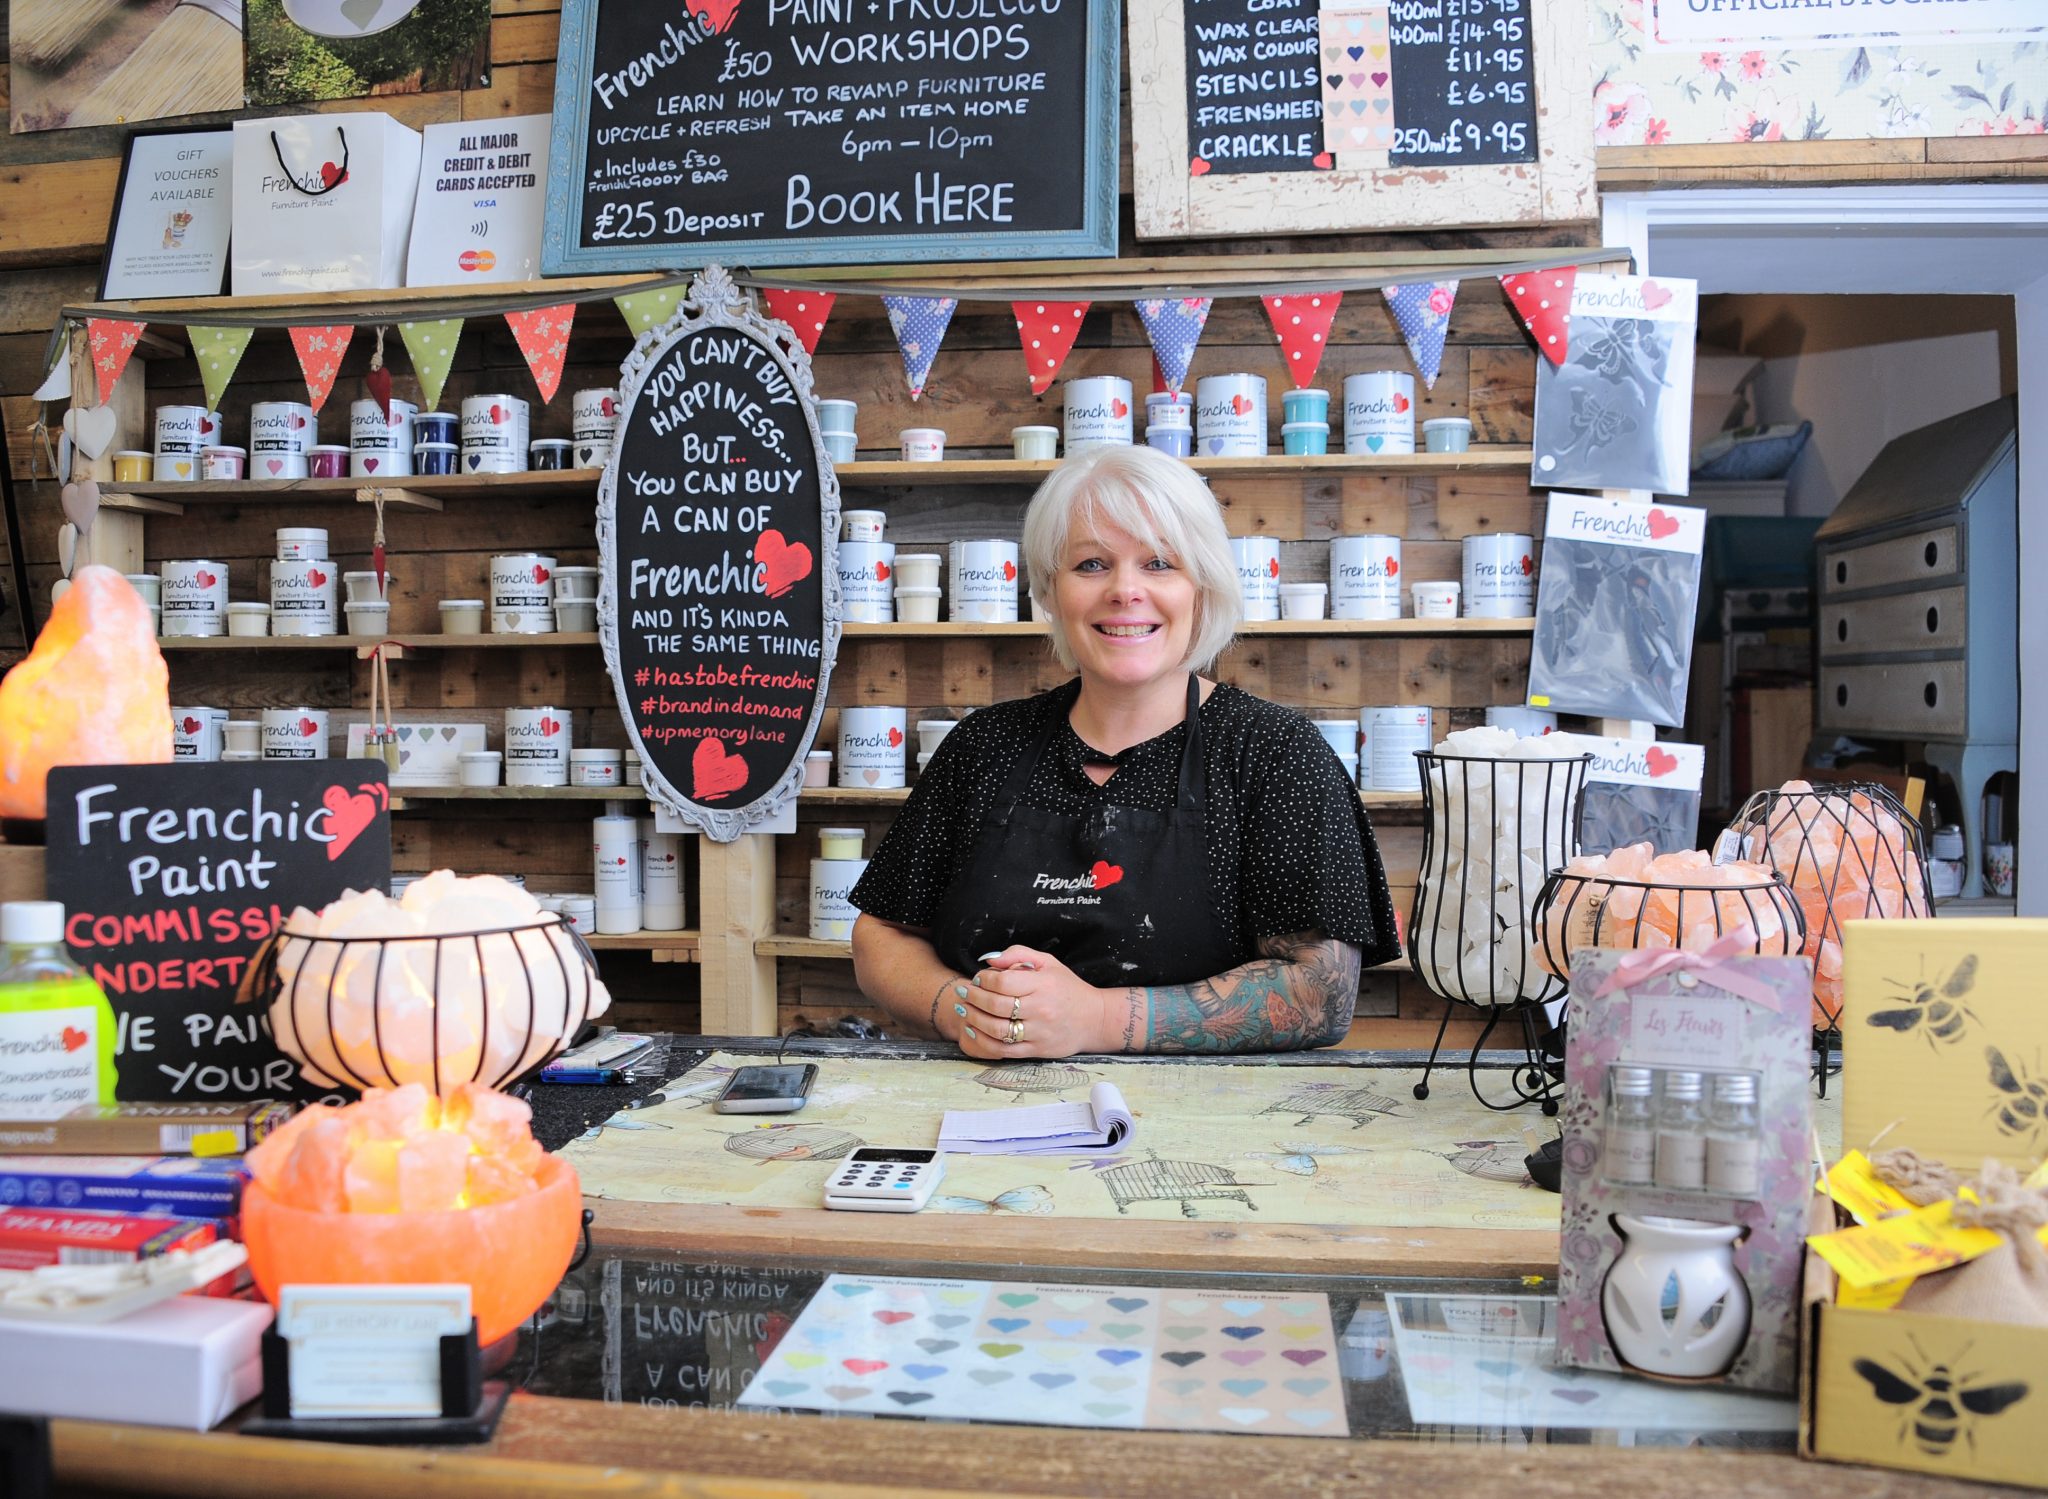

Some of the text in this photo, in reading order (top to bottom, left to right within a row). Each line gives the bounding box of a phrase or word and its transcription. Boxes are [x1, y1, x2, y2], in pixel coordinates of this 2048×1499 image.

[768, 0, 853, 27] PAINT
[1389, 0, 1443, 22] 400ml
[1194, 16, 1525, 45] WAX CLEAR 400ml £14.95
[592, 9, 716, 110] Frenchic
[717, 24, 1031, 83] £50 WORKSHOPS
[1198, 37, 1525, 72] WAX COLOUR £11.95
[656, 72, 1047, 116] LEARN HOW TO REVAMP FURNITURE
[1195, 66, 1528, 105] STENCILS £6.95
[596, 122, 672, 146] UPCYCLE
[690, 115, 772, 137] REFRESH
[785, 110, 845, 129] TAKE
[855, 107, 886, 121] AN
[900, 102, 956, 118] ITEM
[964, 97, 1030, 116] HOME
[459, 132, 519, 152] ALL MAJOR
[841, 126, 994, 161] 6pm 10pm
[1198, 131, 1315, 160] CRACKLE
[1446, 118, 1528, 154] £9.95
[176, 149, 204, 162] GIFT
[443, 153, 532, 173] CREDIT & DEBIT
[606, 149, 721, 177] Includes £30
[154, 166, 219, 183] VOUCHERS
[261, 170, 327, 193] Frenchic
[436, 173, 537, 193] CARDS ACCEPTED
[629, 173, 683, 188] GOODY
[692, 169, 729, 184] BAG
[150, 187, 215, 202] AVAILABLE
[271, 198, 335, 210] Furniture Paint
[473, 200, 497, 208] VISA
[591, 200, 657, 242] £25
[785, 173, 903, 231] BOOK
[914, 171, 1015, 224] HERE
[644, 336, 798, 408] YOU CAN'T BUY
[1068, 404, 1115, 420] Frenchic
[1348, 400, 1398, 415] Frenchic
[627, 469, 803, 496] YOU CAN BUY
[640, 503, 770, 534] A CAN OF
[1571, 510, 1653, 538] Frenchic
[492, 569, 535, 585] Frenchic
[629, 549, 768, 601] Frenchic
[958, 565, 1006, 581] Frenchic
[1339, 563, 1391, 577] Frenchic
[963, 584, 996, 592] Furniture
[631, 603, 790, 631] AND IT'S KINDA
[643, 634, 822, 659] THE SAME THING
[634, 665, 816, 691] #hastobefrenchic
[640, 696, 803, 722] #brandindemand
[640, 722, 786, 746] #upmemorylane
[844, 733, 893, 748] Frenchic
[848, 750, 883, 758] Furniture
[1588, 752, 1652, 776] enchic
[75, 783, 338, 846] Frenchic
[128, 849, 277, 896] Paint
[1032, 869, 1098, 891] Frenchic
[815, 886, 851, 900] French
[1037, 894, 1102, 905] Furniture Paint
[65, 903, 283, 949] COMMISSI
[86, 955, 252, 995] NDERT
[182, 1013, 259, 1050] PAI
[1643, 1009, 1668, 1036] Les
[158, 1059, 295, 1095] YOUR
